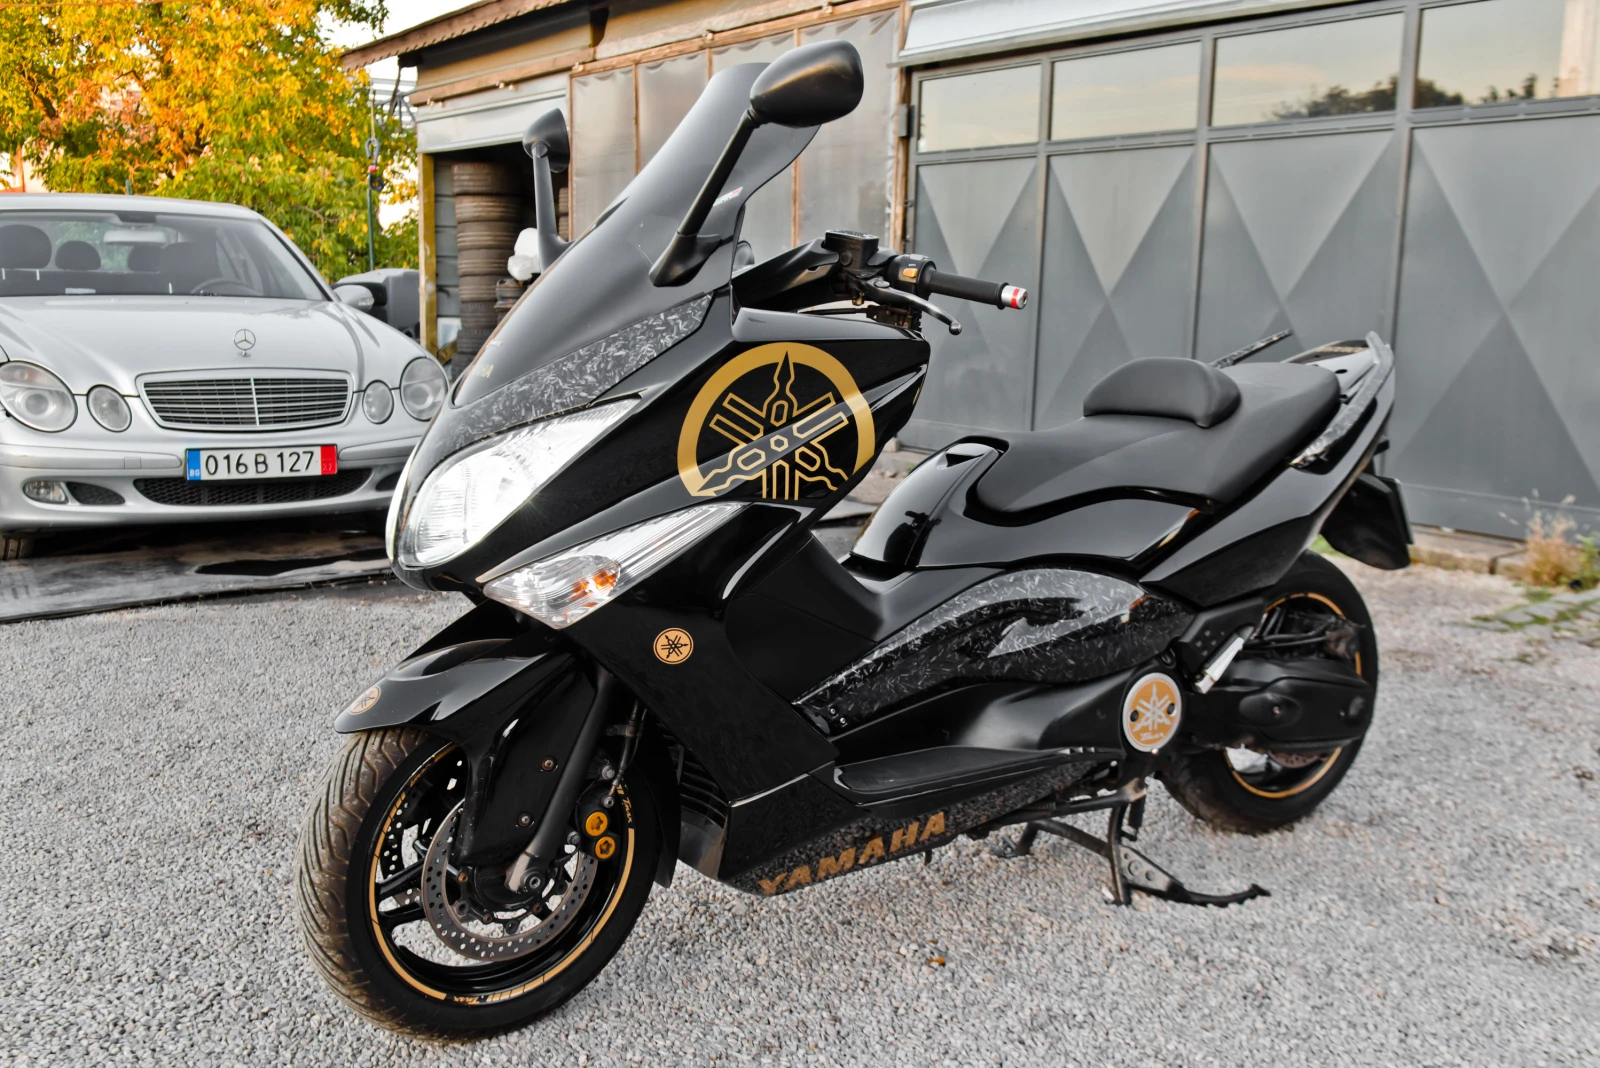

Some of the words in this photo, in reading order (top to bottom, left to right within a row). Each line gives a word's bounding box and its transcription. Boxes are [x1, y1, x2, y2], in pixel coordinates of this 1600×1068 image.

[189, 468, 200, 477] BG
[205, 453, 248, 476] 016
[254, 453, 269, 474] B
[277, 451, 314, 473] 127
[758, 811, 945, 895] YAMAHA
